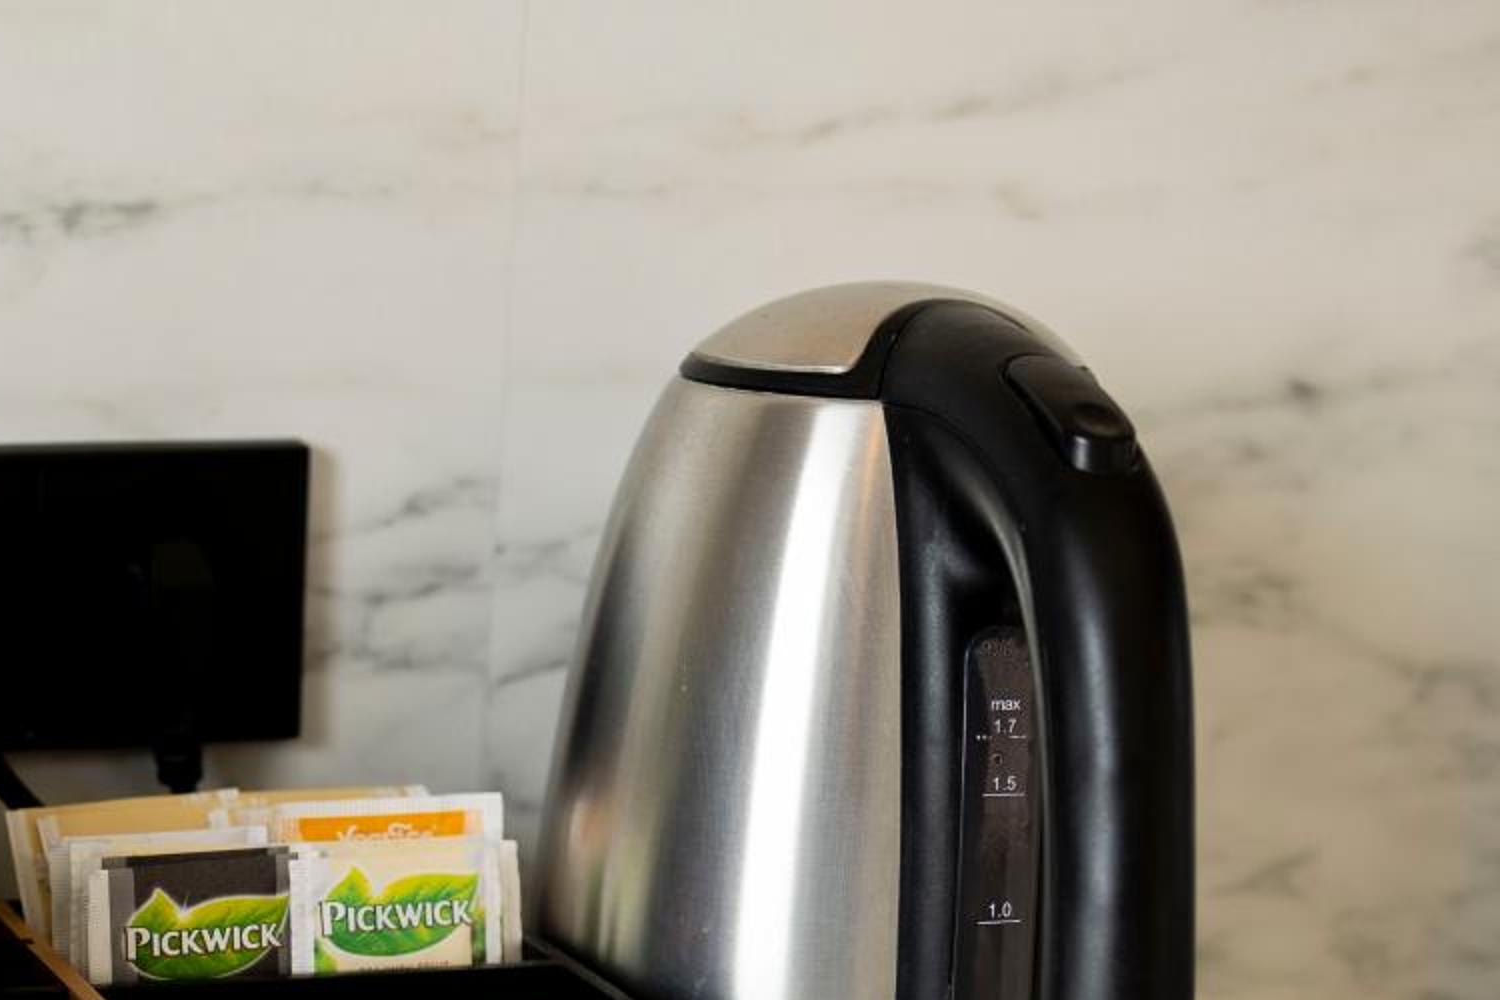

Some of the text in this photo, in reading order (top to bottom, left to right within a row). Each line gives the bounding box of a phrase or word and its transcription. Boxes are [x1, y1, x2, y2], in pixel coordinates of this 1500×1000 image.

[991, 700, 1021, 711] max
[993, 719, 1018, 734] 1.7
[993, 777, 1018, 791] 1.5
[988, 903, 1013, 917] 1.0
[321, 898, 476, 937] PICKWICK
[124, 922, 284, 962] PICKWICK
